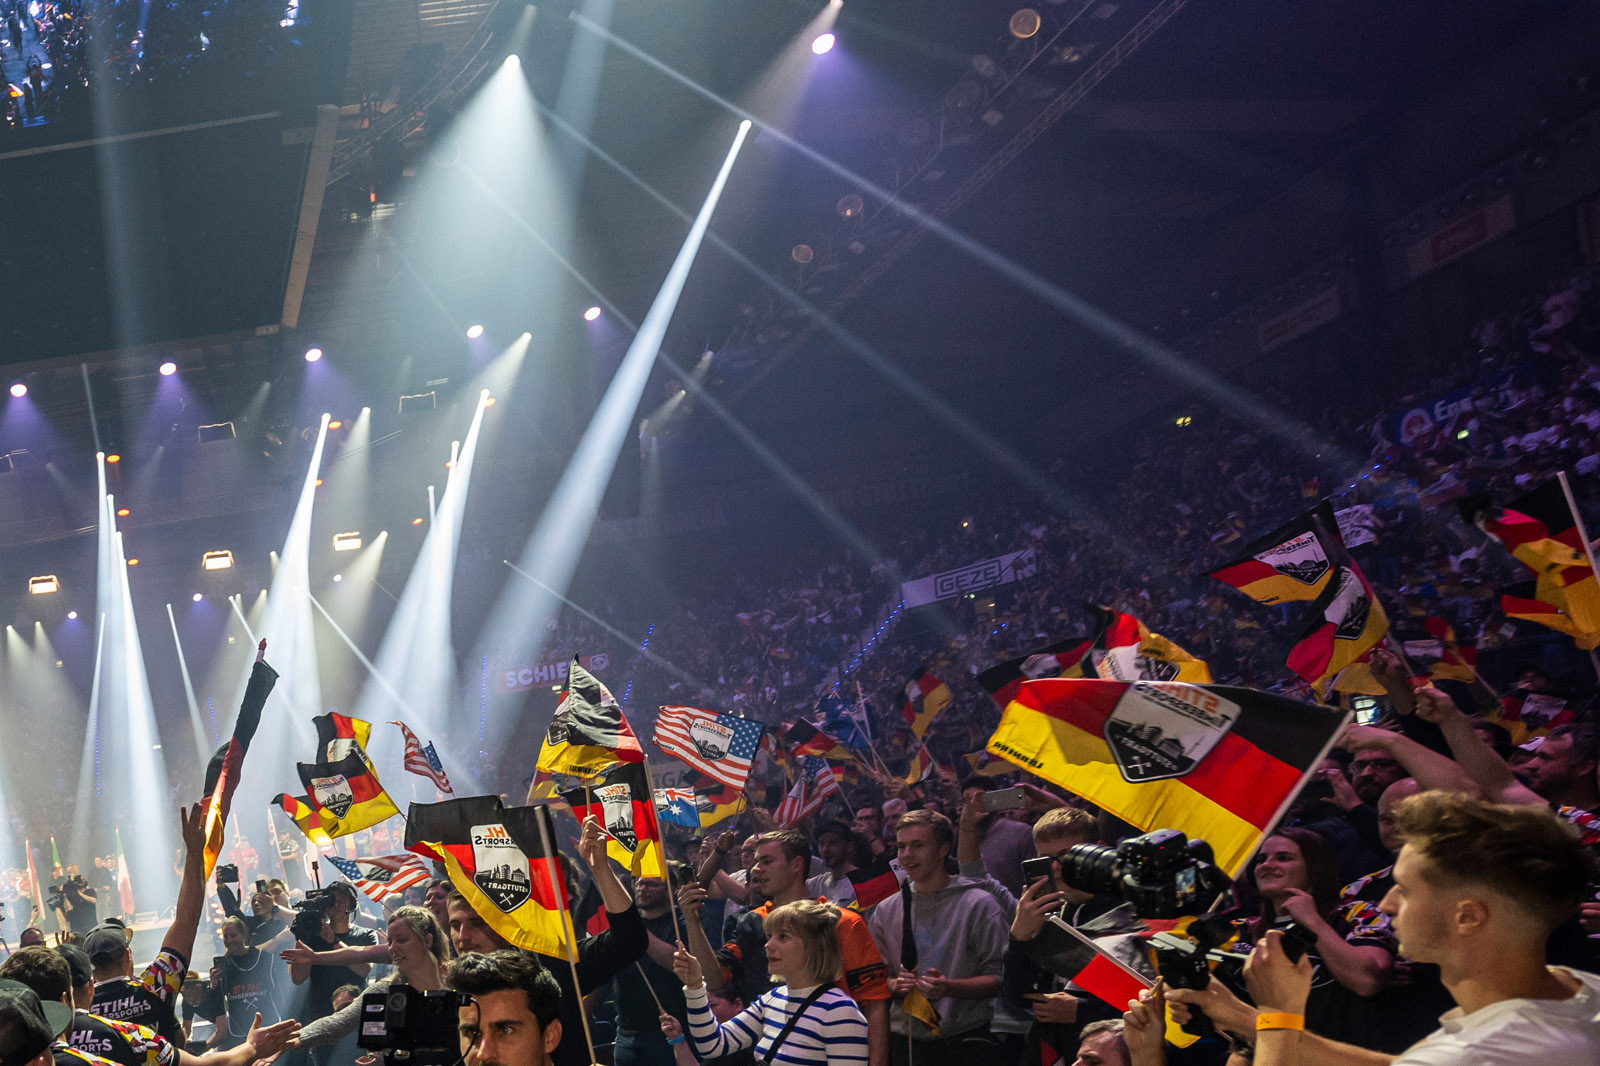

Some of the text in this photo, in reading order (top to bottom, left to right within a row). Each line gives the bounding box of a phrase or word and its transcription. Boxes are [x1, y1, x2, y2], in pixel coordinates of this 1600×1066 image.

[941, 564, 997, 592] GEZE
[505, 661, 570, 688] SCHIE
[90, 995, 141, 1016] STIHL
